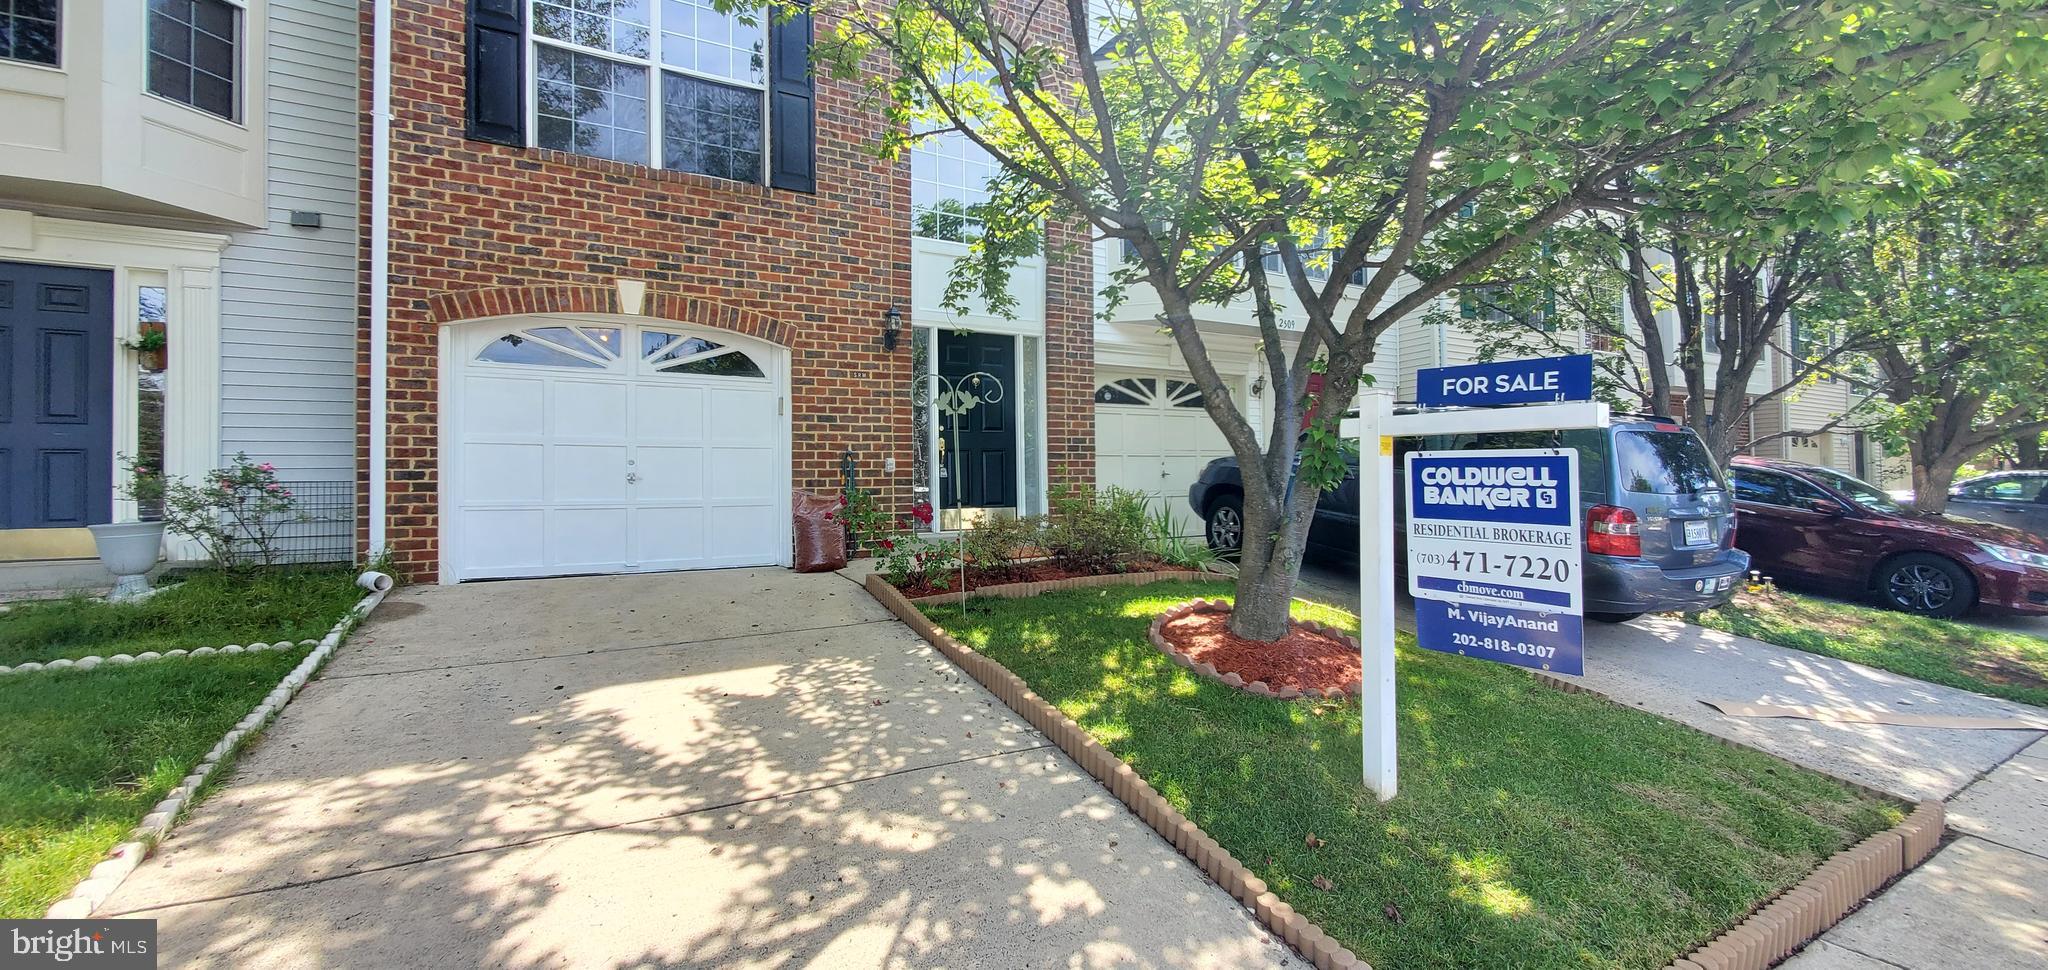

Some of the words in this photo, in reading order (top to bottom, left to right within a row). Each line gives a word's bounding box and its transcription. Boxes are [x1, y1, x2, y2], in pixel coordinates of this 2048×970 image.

[1279, 319, 1295, 329] 2509
[1442, 376, 1488, 396] FOR
[1495, 371, 1560, 393] SALE
[1421, 466, 1558, 487] COLDWELL
[1424, 486, 1531, 510] BANKER
[1413, 523, 1490, 540] RESIDENTIAL
[1493, 527, 1572, 546] BROKERAGE
[1457, 581, 1524, 600] cbmove.com
[1448, 607, 1465, 621] M.
[1468, 610, 1559, 633] VijayAnand
[1452, 632, 1556, 659] 202-818-0307
